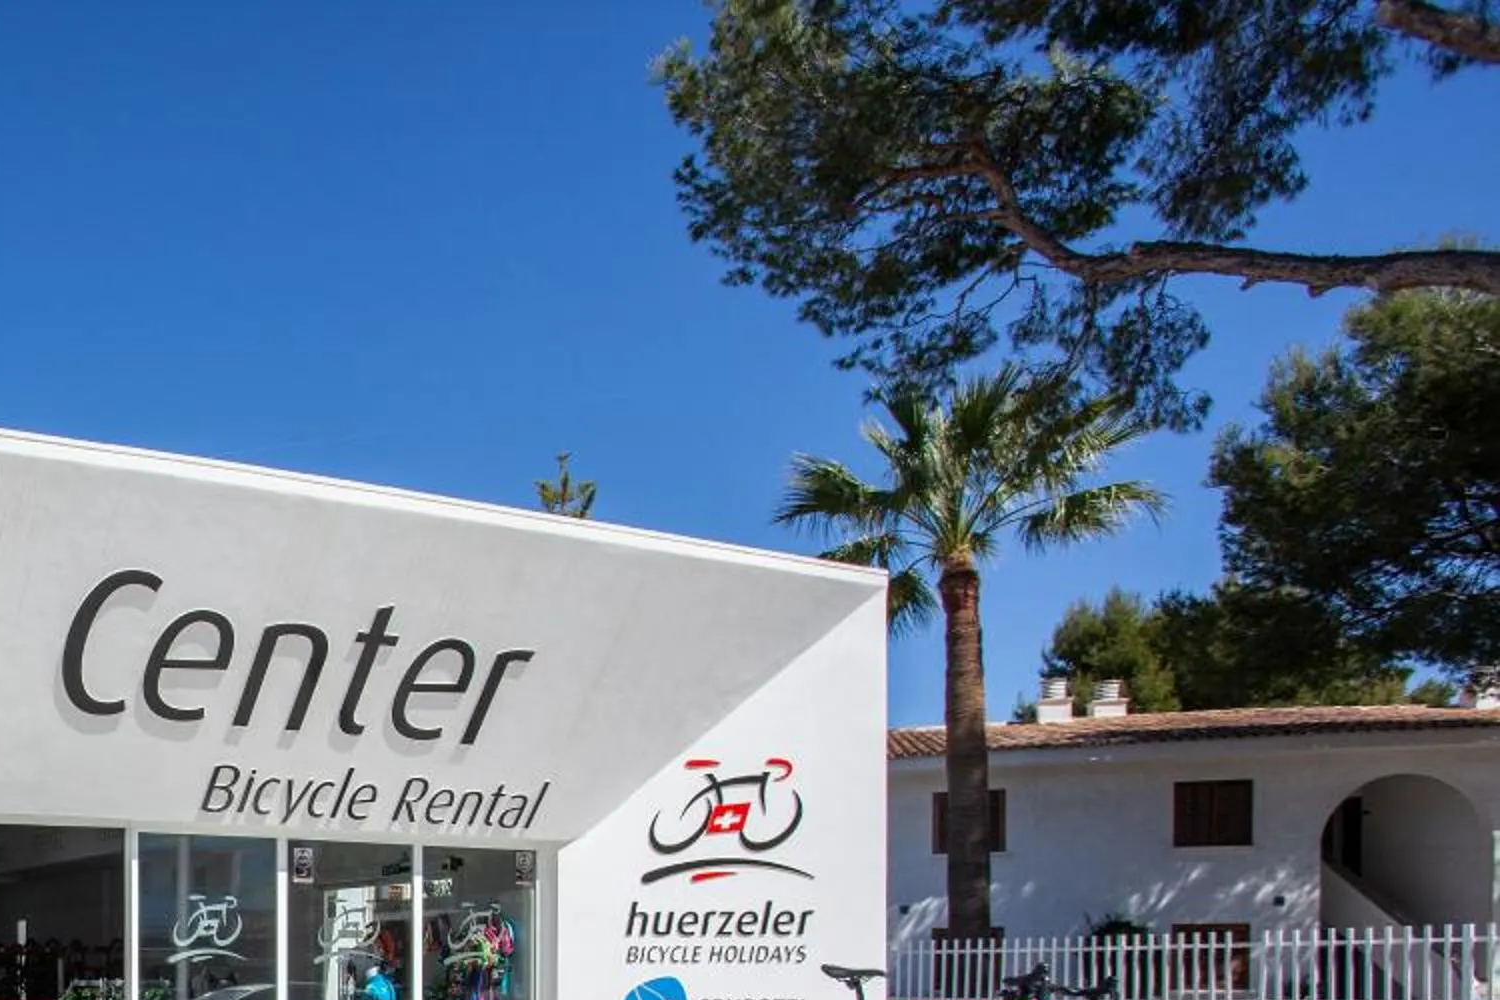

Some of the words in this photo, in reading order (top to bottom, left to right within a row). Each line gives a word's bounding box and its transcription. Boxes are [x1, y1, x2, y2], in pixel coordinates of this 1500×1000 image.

[61, 569, 536, 746] Center
[200, 764, 379, 825] Bicycle
[391, 775, 552, 830] Rental
[625, 900, 815, 938] huerzeler
[626, 945, 702, 964] BICYCLE
[708, 945, 807, 963] HOLIDAYS
